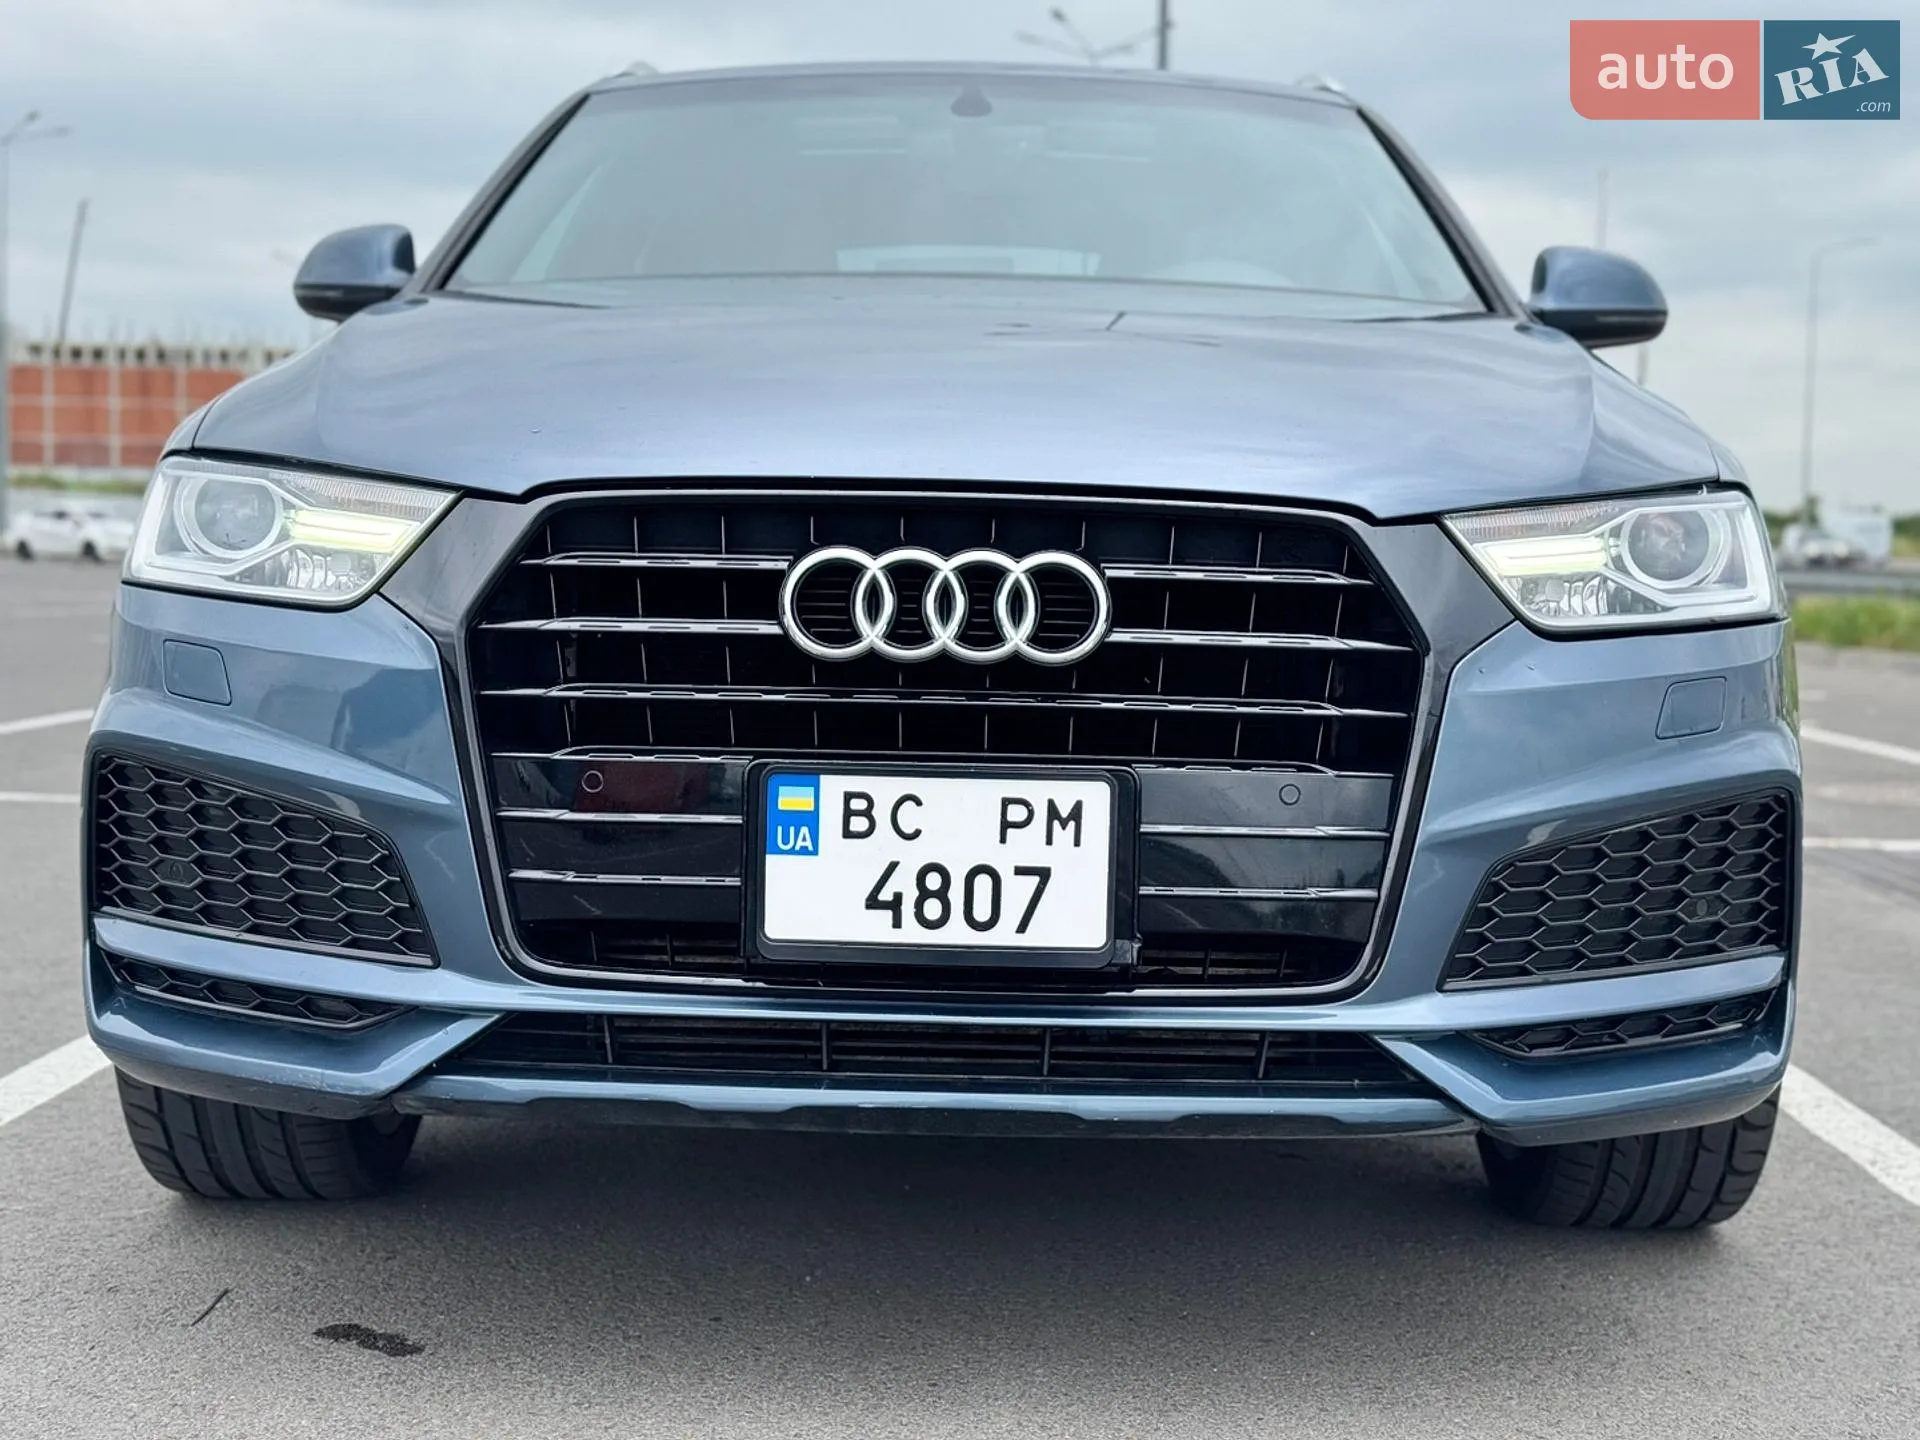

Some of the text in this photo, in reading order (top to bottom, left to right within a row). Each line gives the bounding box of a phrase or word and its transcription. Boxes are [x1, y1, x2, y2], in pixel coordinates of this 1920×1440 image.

[777, 825, 814, 851] UA
[842, 791, 1083, 847] BC PM
[865, 861, 1052, 934] 4807
